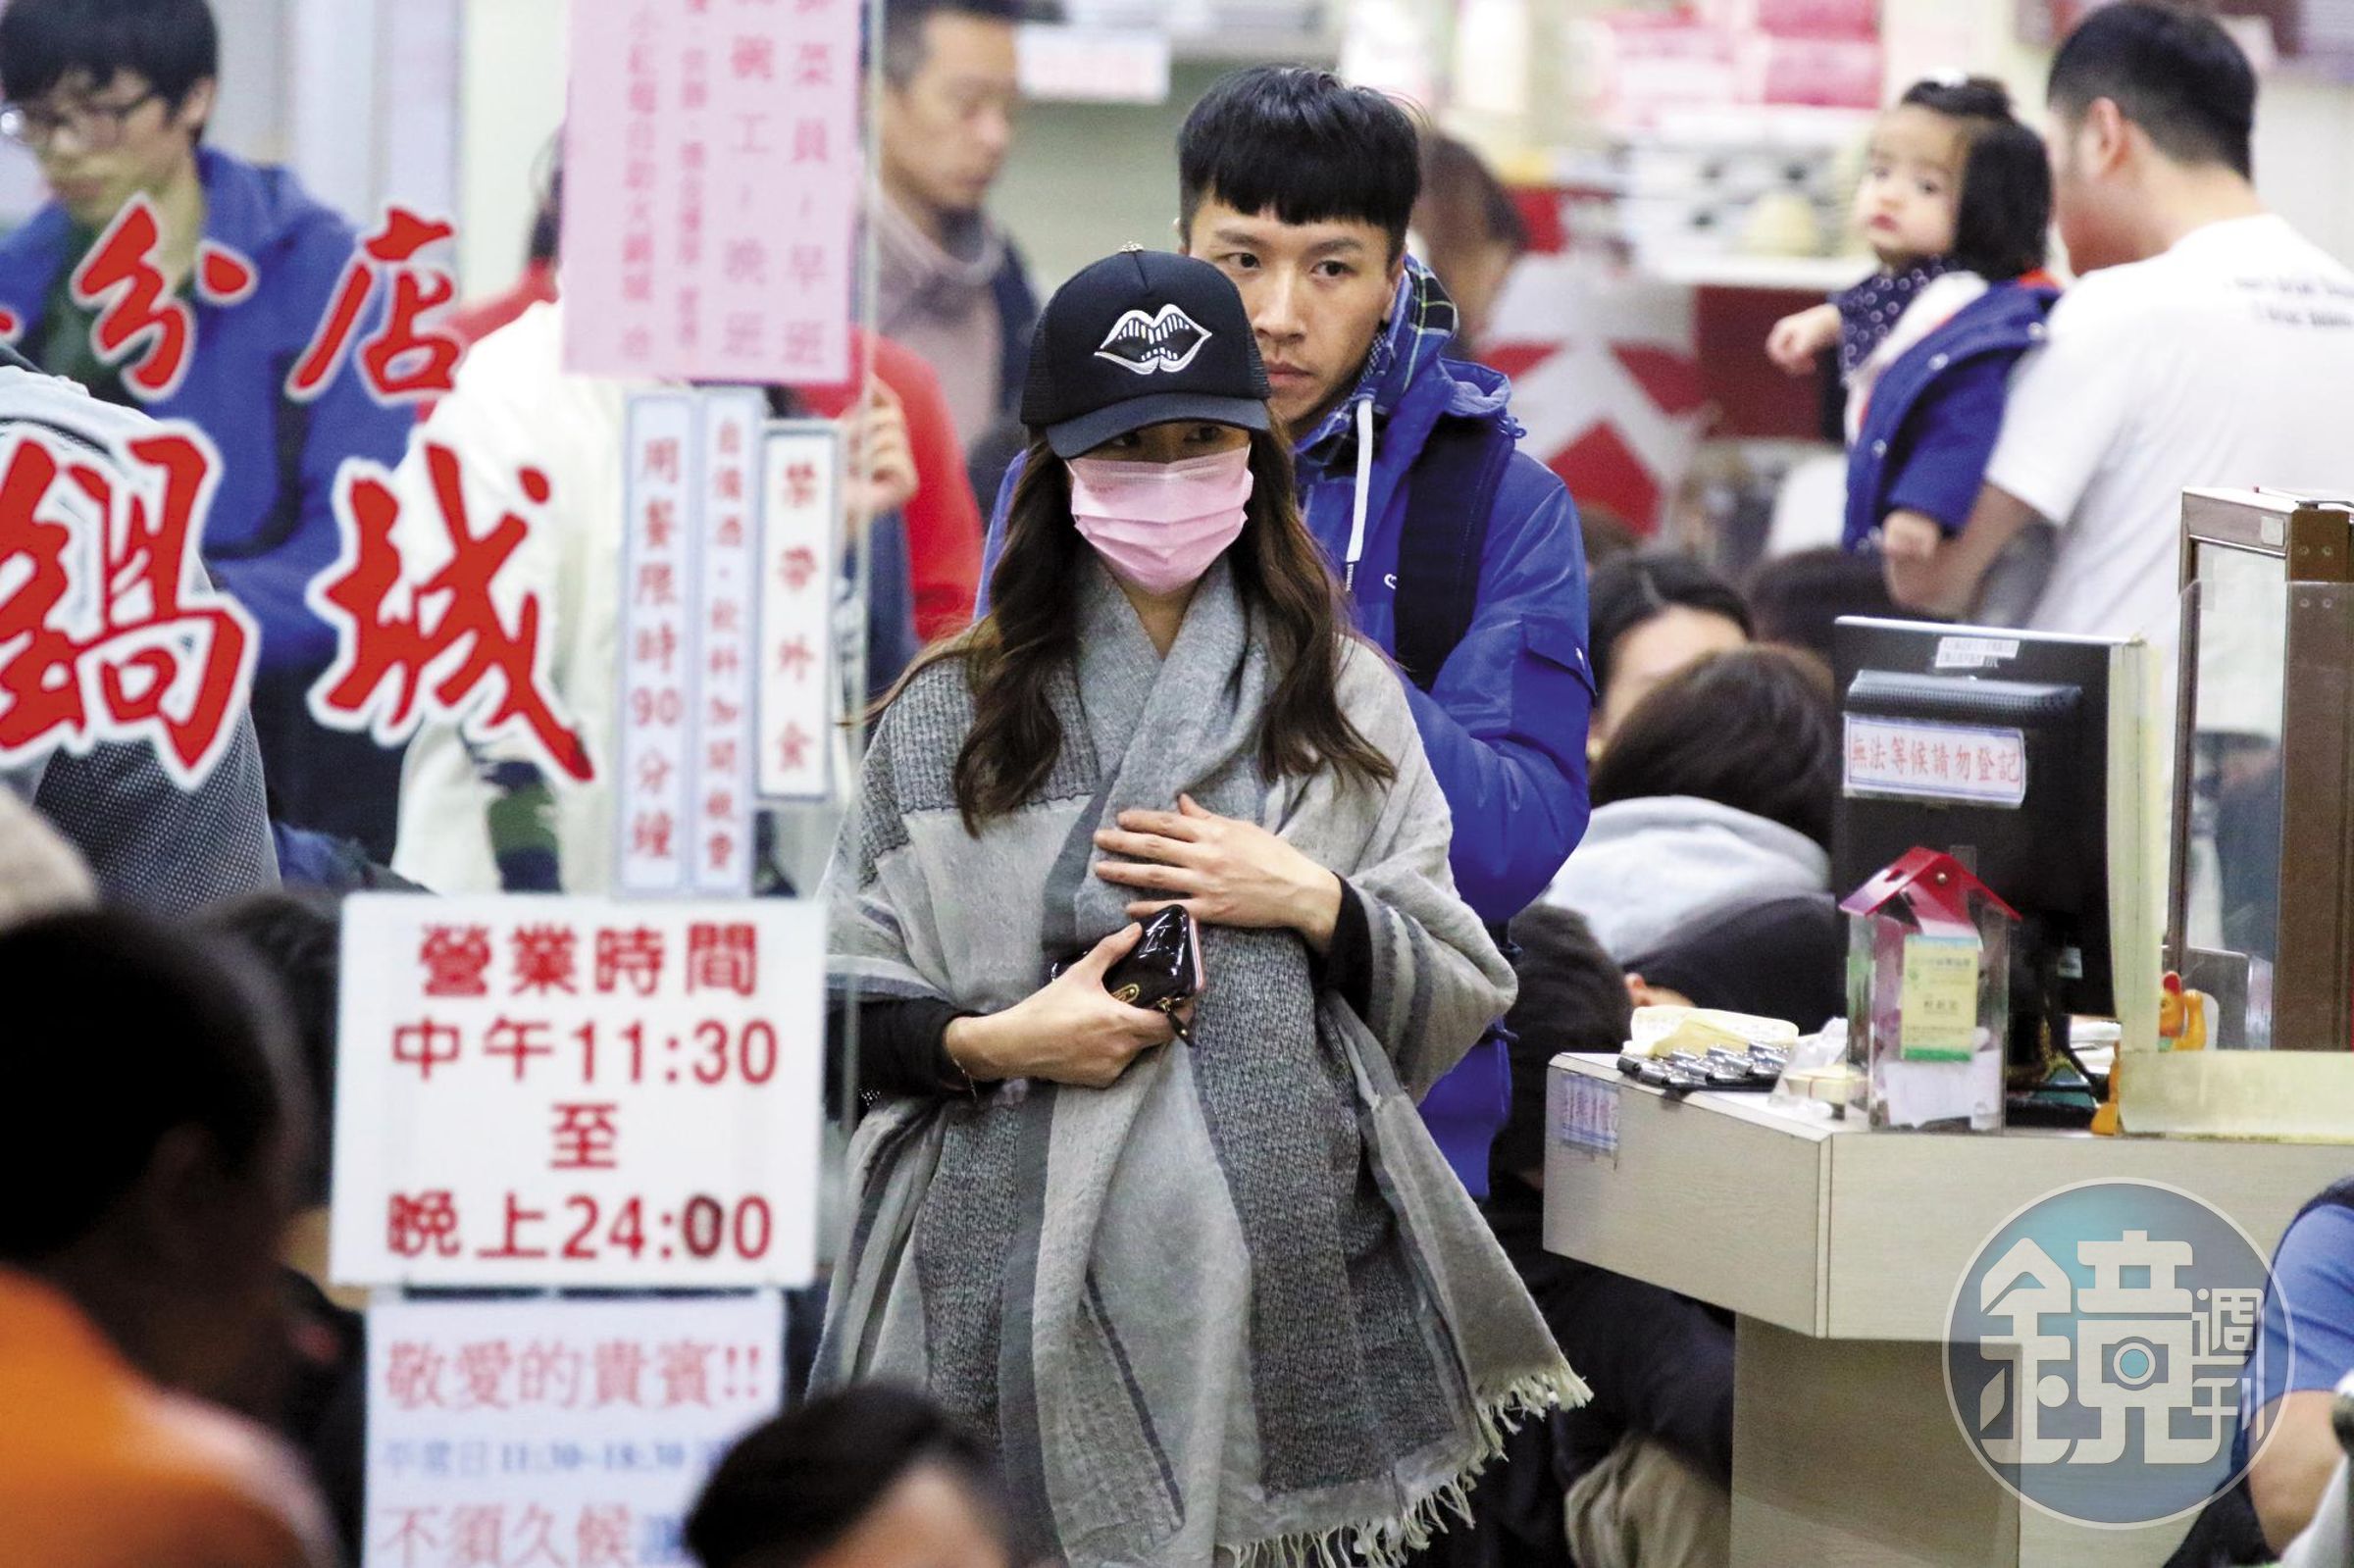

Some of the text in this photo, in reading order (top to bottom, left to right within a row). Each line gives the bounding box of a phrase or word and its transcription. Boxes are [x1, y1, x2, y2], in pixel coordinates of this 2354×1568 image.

[0, 204, 461, 392] 分店
[0, 435, 594, 781] 鍋城
[779, 462, 817, 773] 禁帶外食
[1852, 734, 2021, 783] 無法等候請勿登記
[419, 923, 758, 996] 營業時間
[392, 1017, 778, 1085] 中午11:30
[548, 1102, 618, 1170] 至
[387, 1189, 773, 1260] 晚上24:00
[386, 1339, 761, 1410] 敬愛的貴賓!!
